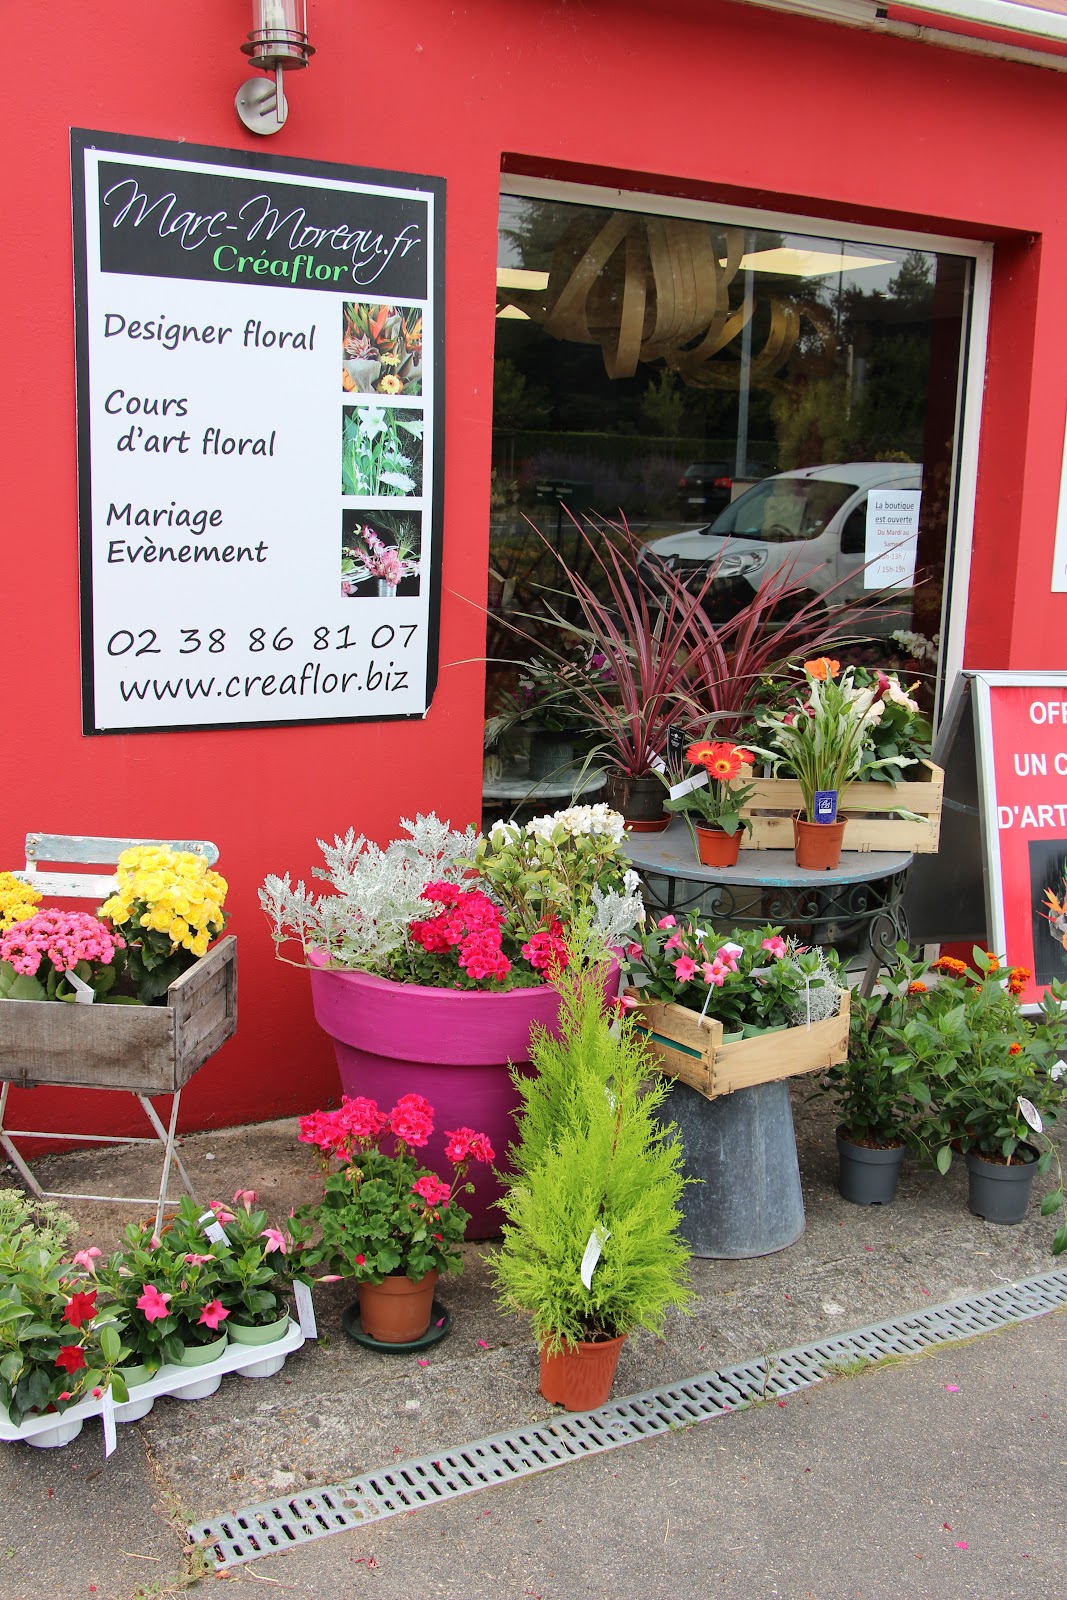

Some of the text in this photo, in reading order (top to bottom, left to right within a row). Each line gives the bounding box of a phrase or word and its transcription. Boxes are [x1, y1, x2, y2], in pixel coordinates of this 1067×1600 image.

[104, 179, 422, 285] Marc-Moreau.fr
[213, 245, 348, 283] Créaflor
[104, 313, 316, 351] Designer floral
[104, 389, 188, 417] Cours
[117, 426, 276, 457] d'art floral
[107, 502, 223, 535] Mariage
[875, 502, 915, 511] La boutique
[107, 537, 268, 564] Evènement
[107, 624, 418, 657] 02 38 86 81 07
[120, 660, 409, 702] www.creaflor.biz
[1014, 753, 1047, 776] UN
[997, 804, 1067, 829] D'ART
